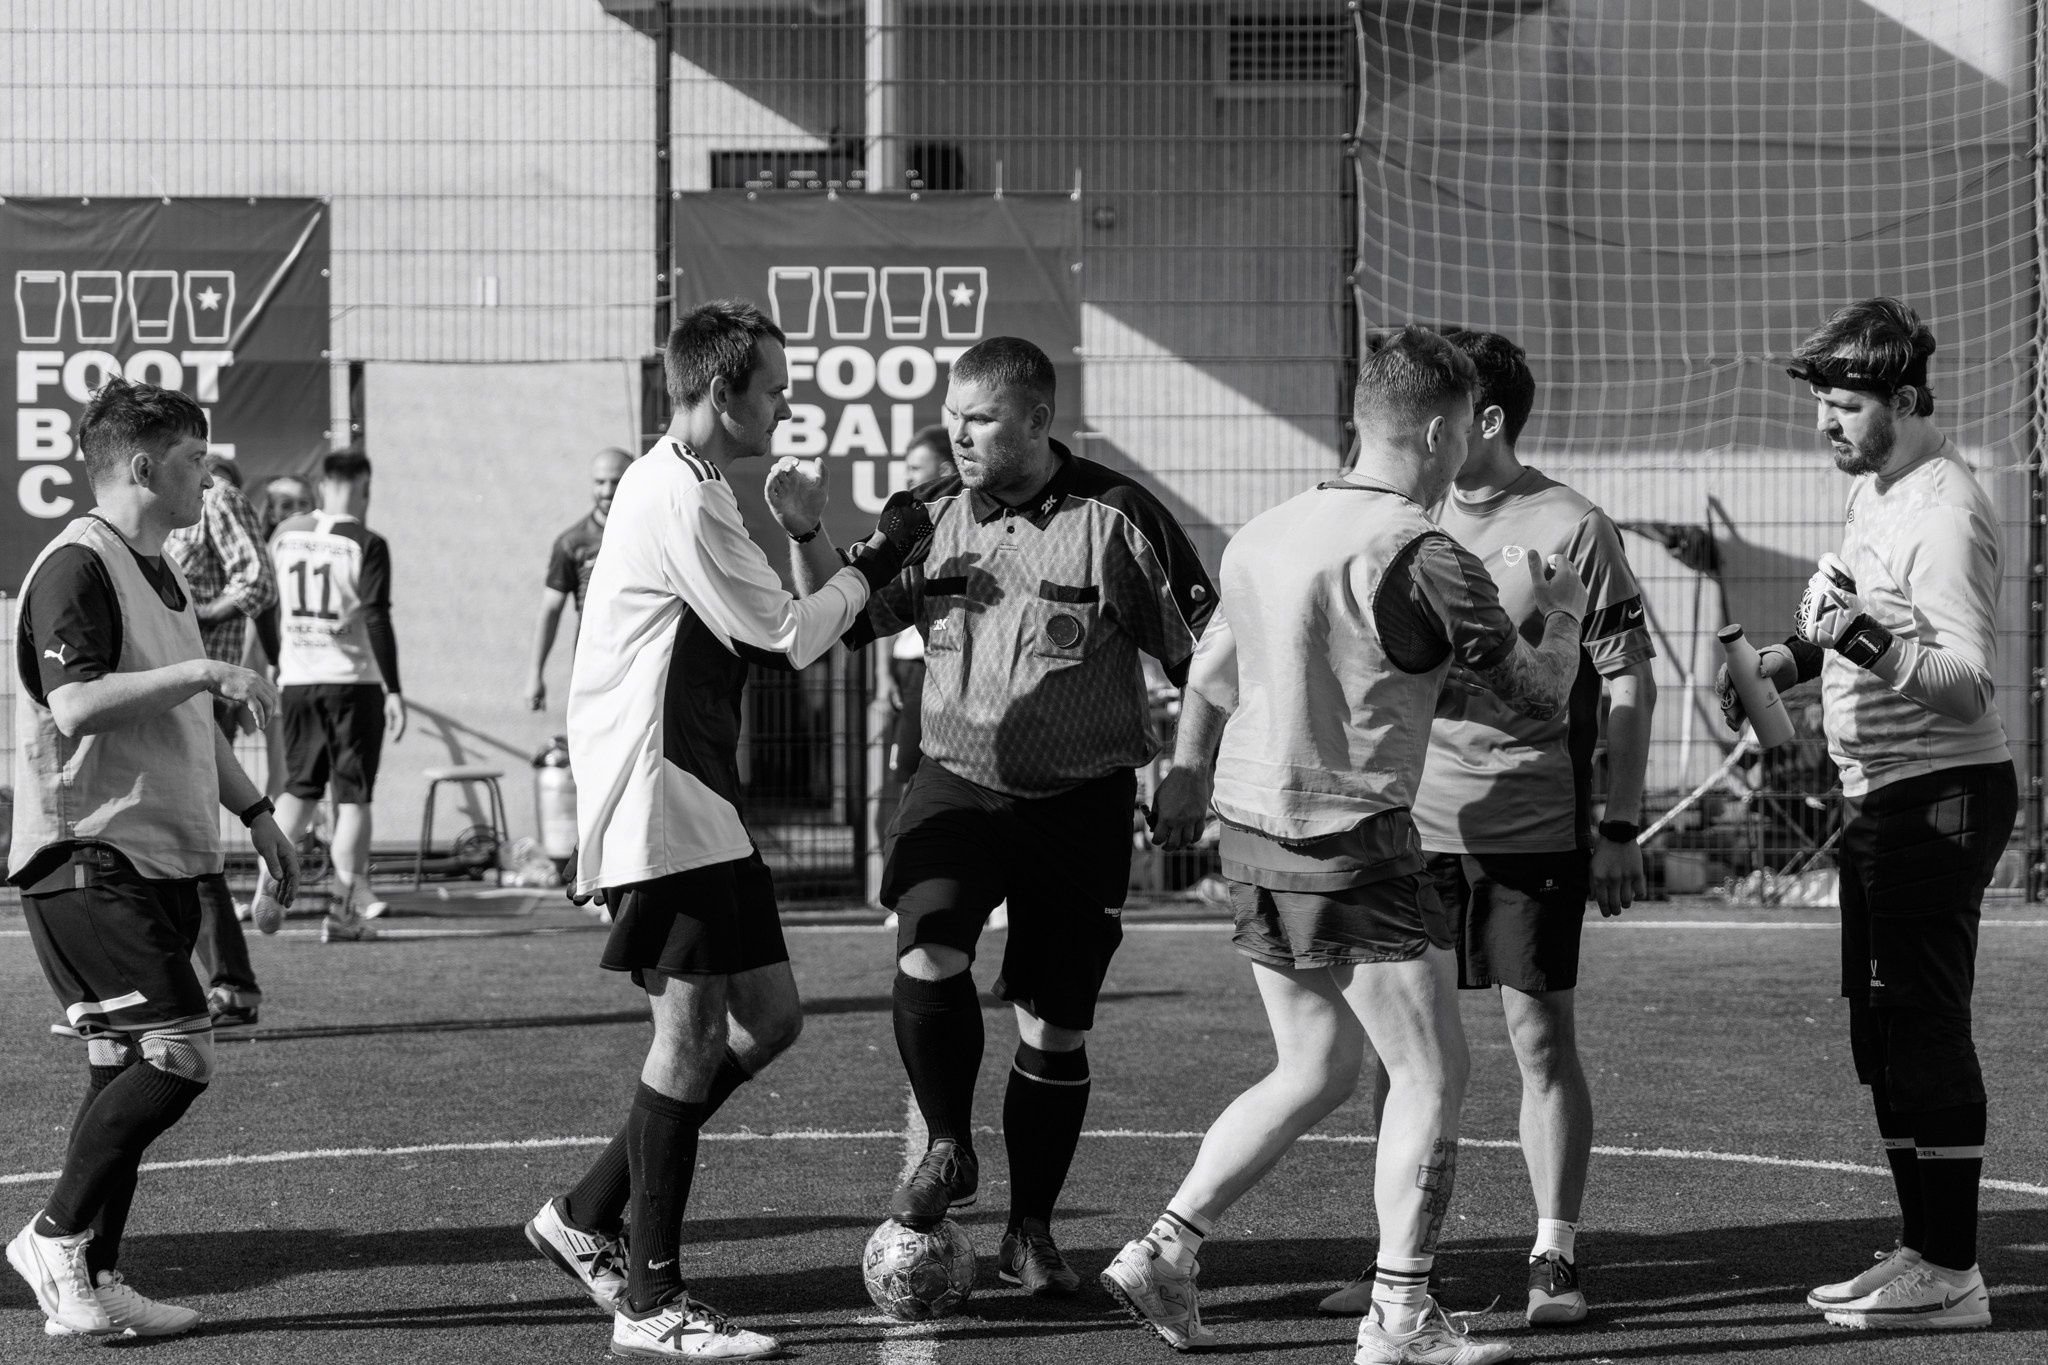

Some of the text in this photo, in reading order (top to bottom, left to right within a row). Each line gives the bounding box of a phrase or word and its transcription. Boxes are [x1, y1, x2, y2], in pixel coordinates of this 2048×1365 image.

[771, 404, 949, 456] BAL
[1041, 494, 1058, 515] 2K
[289, 560, 339, 620] 11
[1858, 634, 1879, 653] COMFORT
